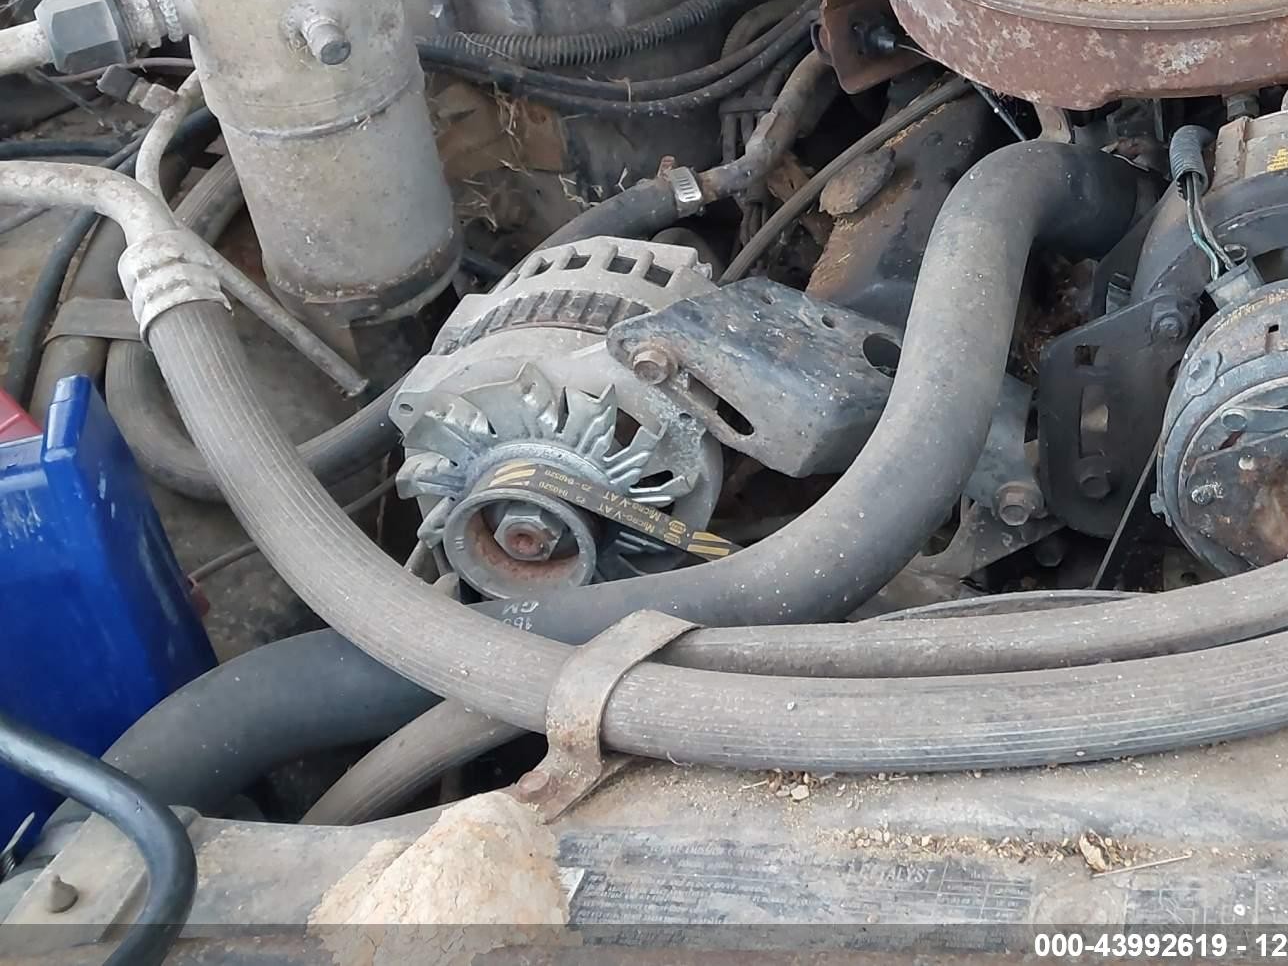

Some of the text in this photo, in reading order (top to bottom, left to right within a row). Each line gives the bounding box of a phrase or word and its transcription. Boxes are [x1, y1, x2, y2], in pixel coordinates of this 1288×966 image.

[603, 491, 620, 502] AT
[598, 504, 613, 515] AT
[502, 601, 539, 615] GM
